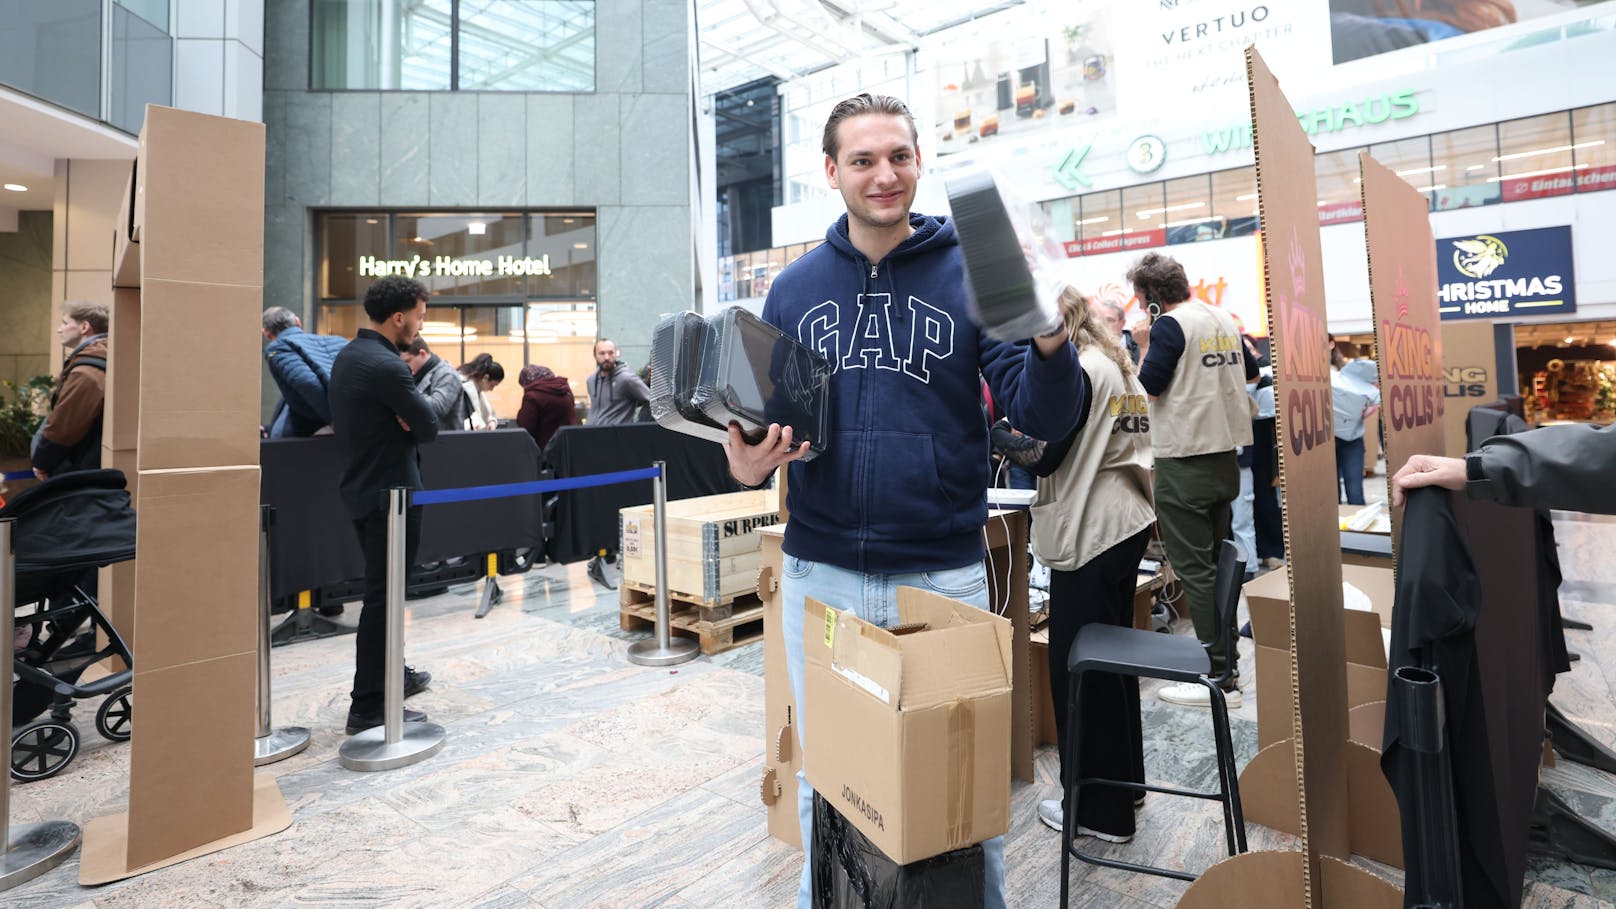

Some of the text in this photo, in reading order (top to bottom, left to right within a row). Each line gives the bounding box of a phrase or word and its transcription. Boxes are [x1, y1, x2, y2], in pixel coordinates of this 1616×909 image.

[1161, 5, 1269, 45] VERTUO
[359, 253, 551, 279] Harry's Home Hotel
[1437, 275, 1563, 302] HRISTMAS
[1464, 299, 1509, 314] HOME
[797, 292, 955, 384] GAP
[1382, 320, 1433, 380] KING
[1441, 366, 1488, 385] NG
[1443, 384, 1486, 398] LIS
[1288, 388, 1332, 457] COLIS
[1390, 384, 1434, 432] COLIS
[841, 783, 885, 832] JONKASIPA
